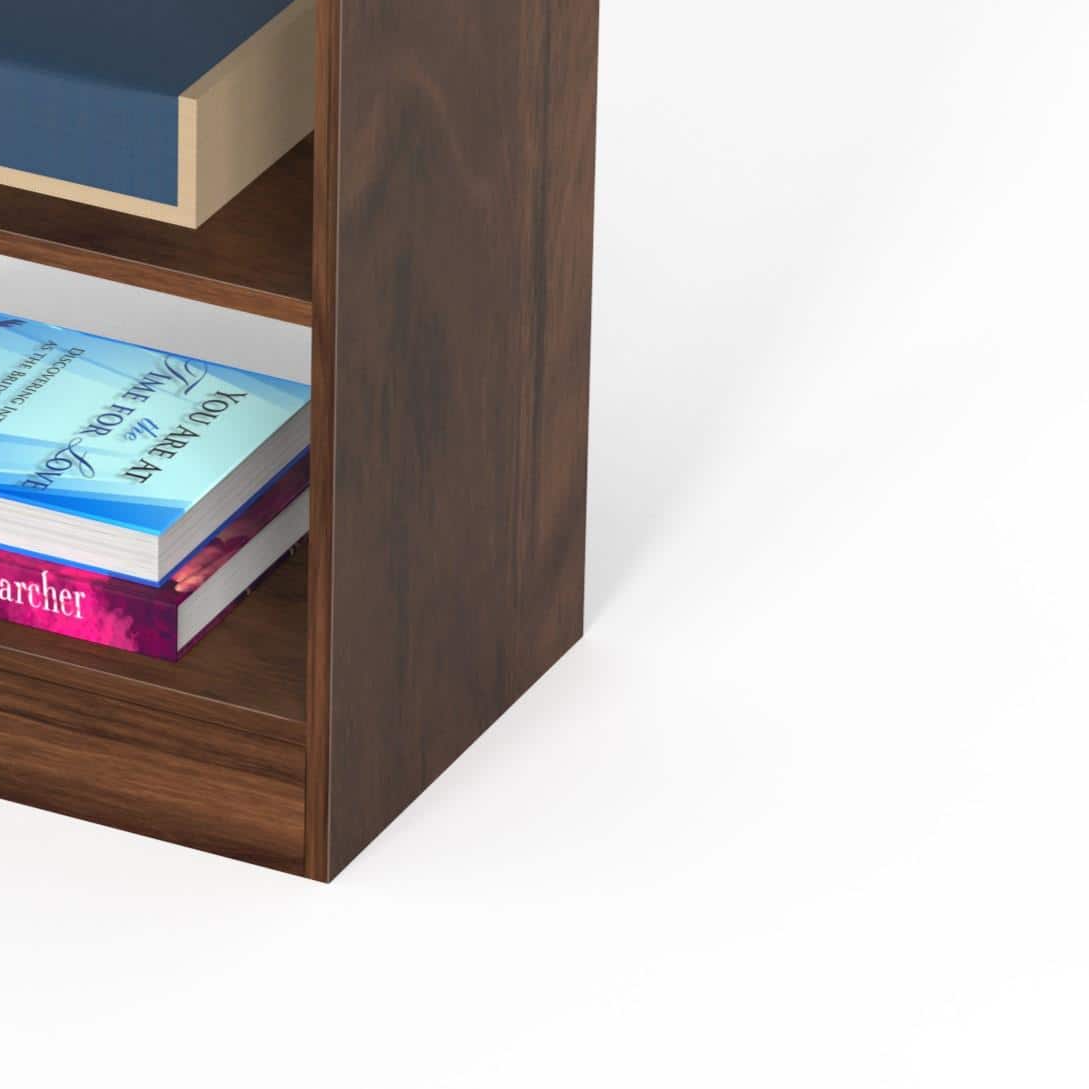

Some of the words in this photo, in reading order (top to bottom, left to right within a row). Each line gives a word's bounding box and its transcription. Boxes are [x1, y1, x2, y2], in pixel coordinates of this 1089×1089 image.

[19, 352, 47, 370] THE
[39, 340, 58, 353] AS
[10, 347, 86, 406] DISCOVERING
[80, 403, 136, 437] FOR
[188, 390, 248, 427] YOU
[125, 416, 160, 442] the
[148, 425, 200, 460] ARE
[124, 459, 163, 484] AT
